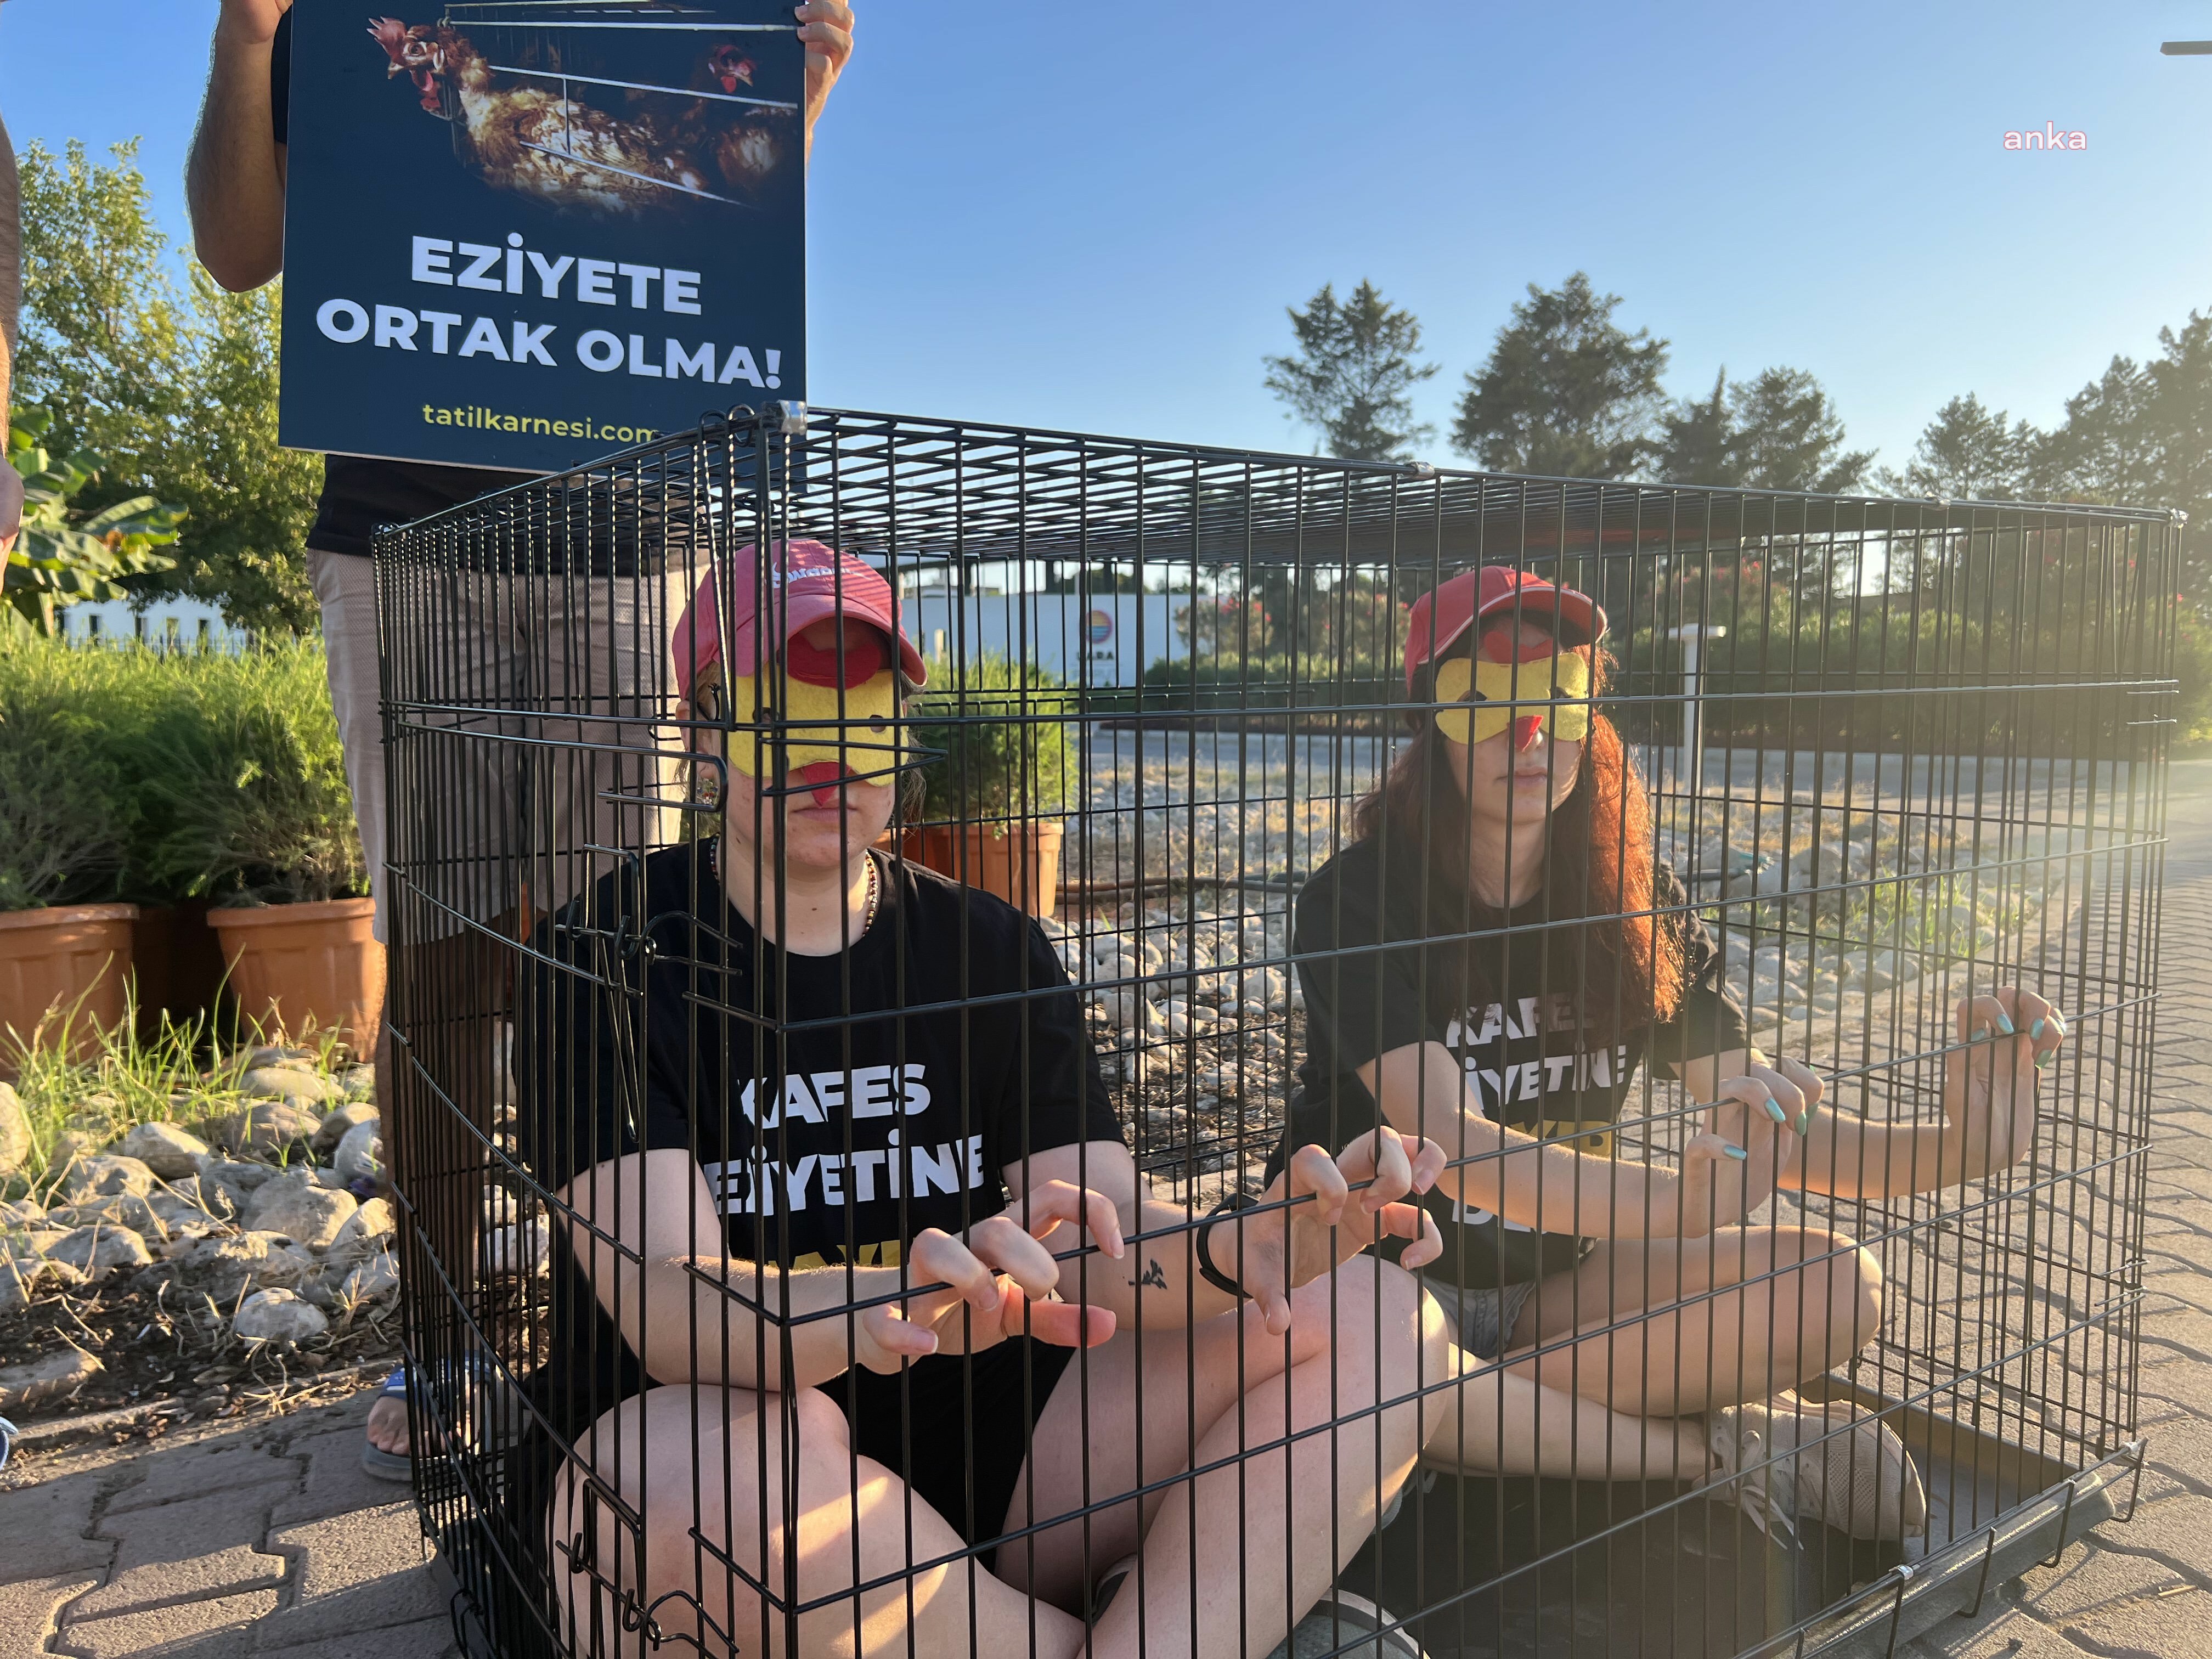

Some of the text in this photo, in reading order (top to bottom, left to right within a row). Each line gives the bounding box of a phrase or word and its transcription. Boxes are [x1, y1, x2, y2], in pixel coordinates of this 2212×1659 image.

[412, 232, 702, 315] EZİYETE
[316, 298, 782, 389] ORTAK OLMA!
